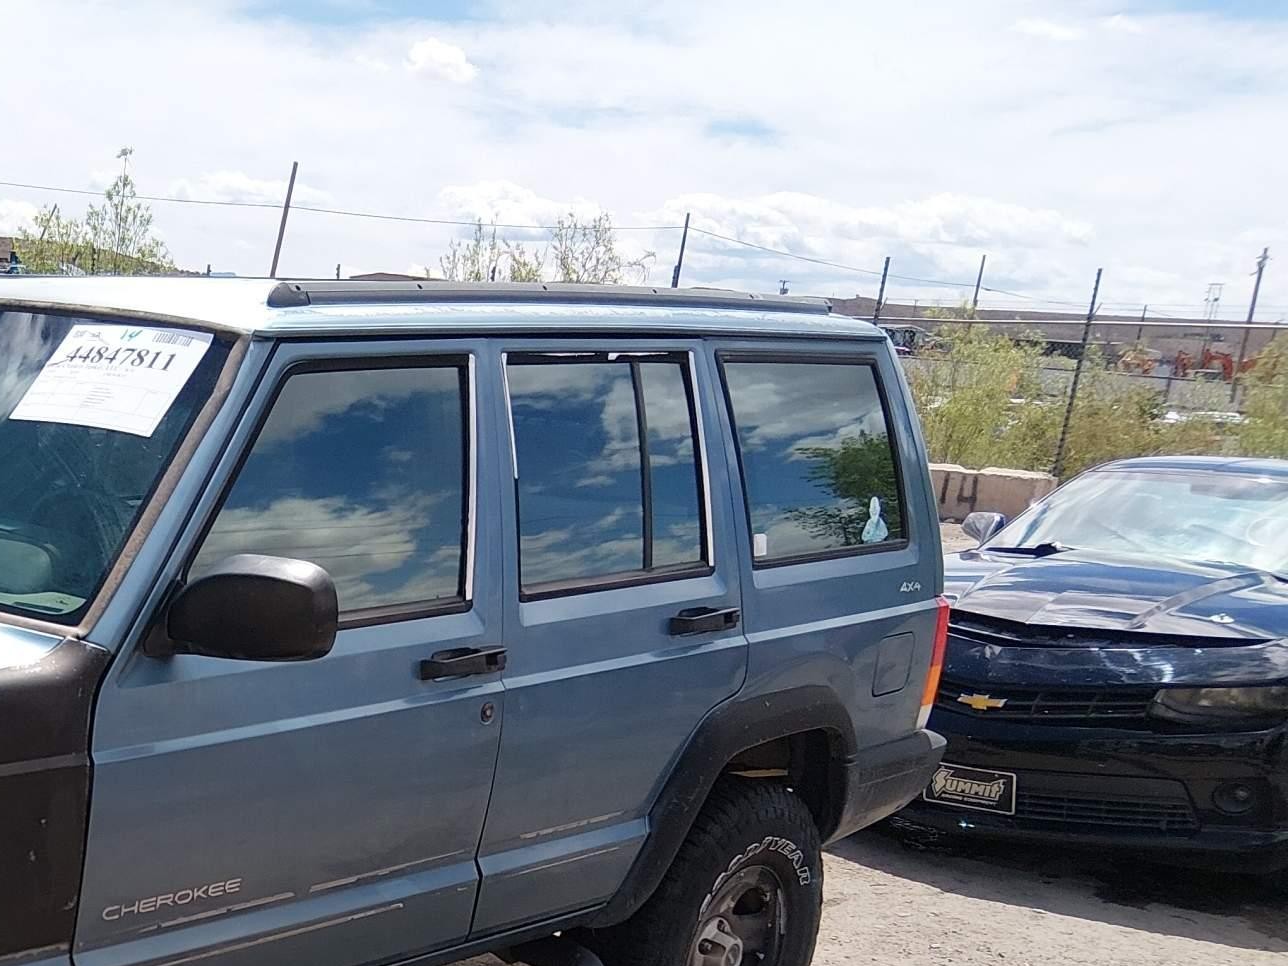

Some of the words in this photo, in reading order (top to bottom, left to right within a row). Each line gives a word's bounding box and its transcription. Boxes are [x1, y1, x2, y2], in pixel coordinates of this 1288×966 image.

[120, 328, 144, 342] 14
[66, 345, 177, 372] 44847811
[940, 471, 978, 512] 14
[102, 878, 242, 920] CHEROKEE
